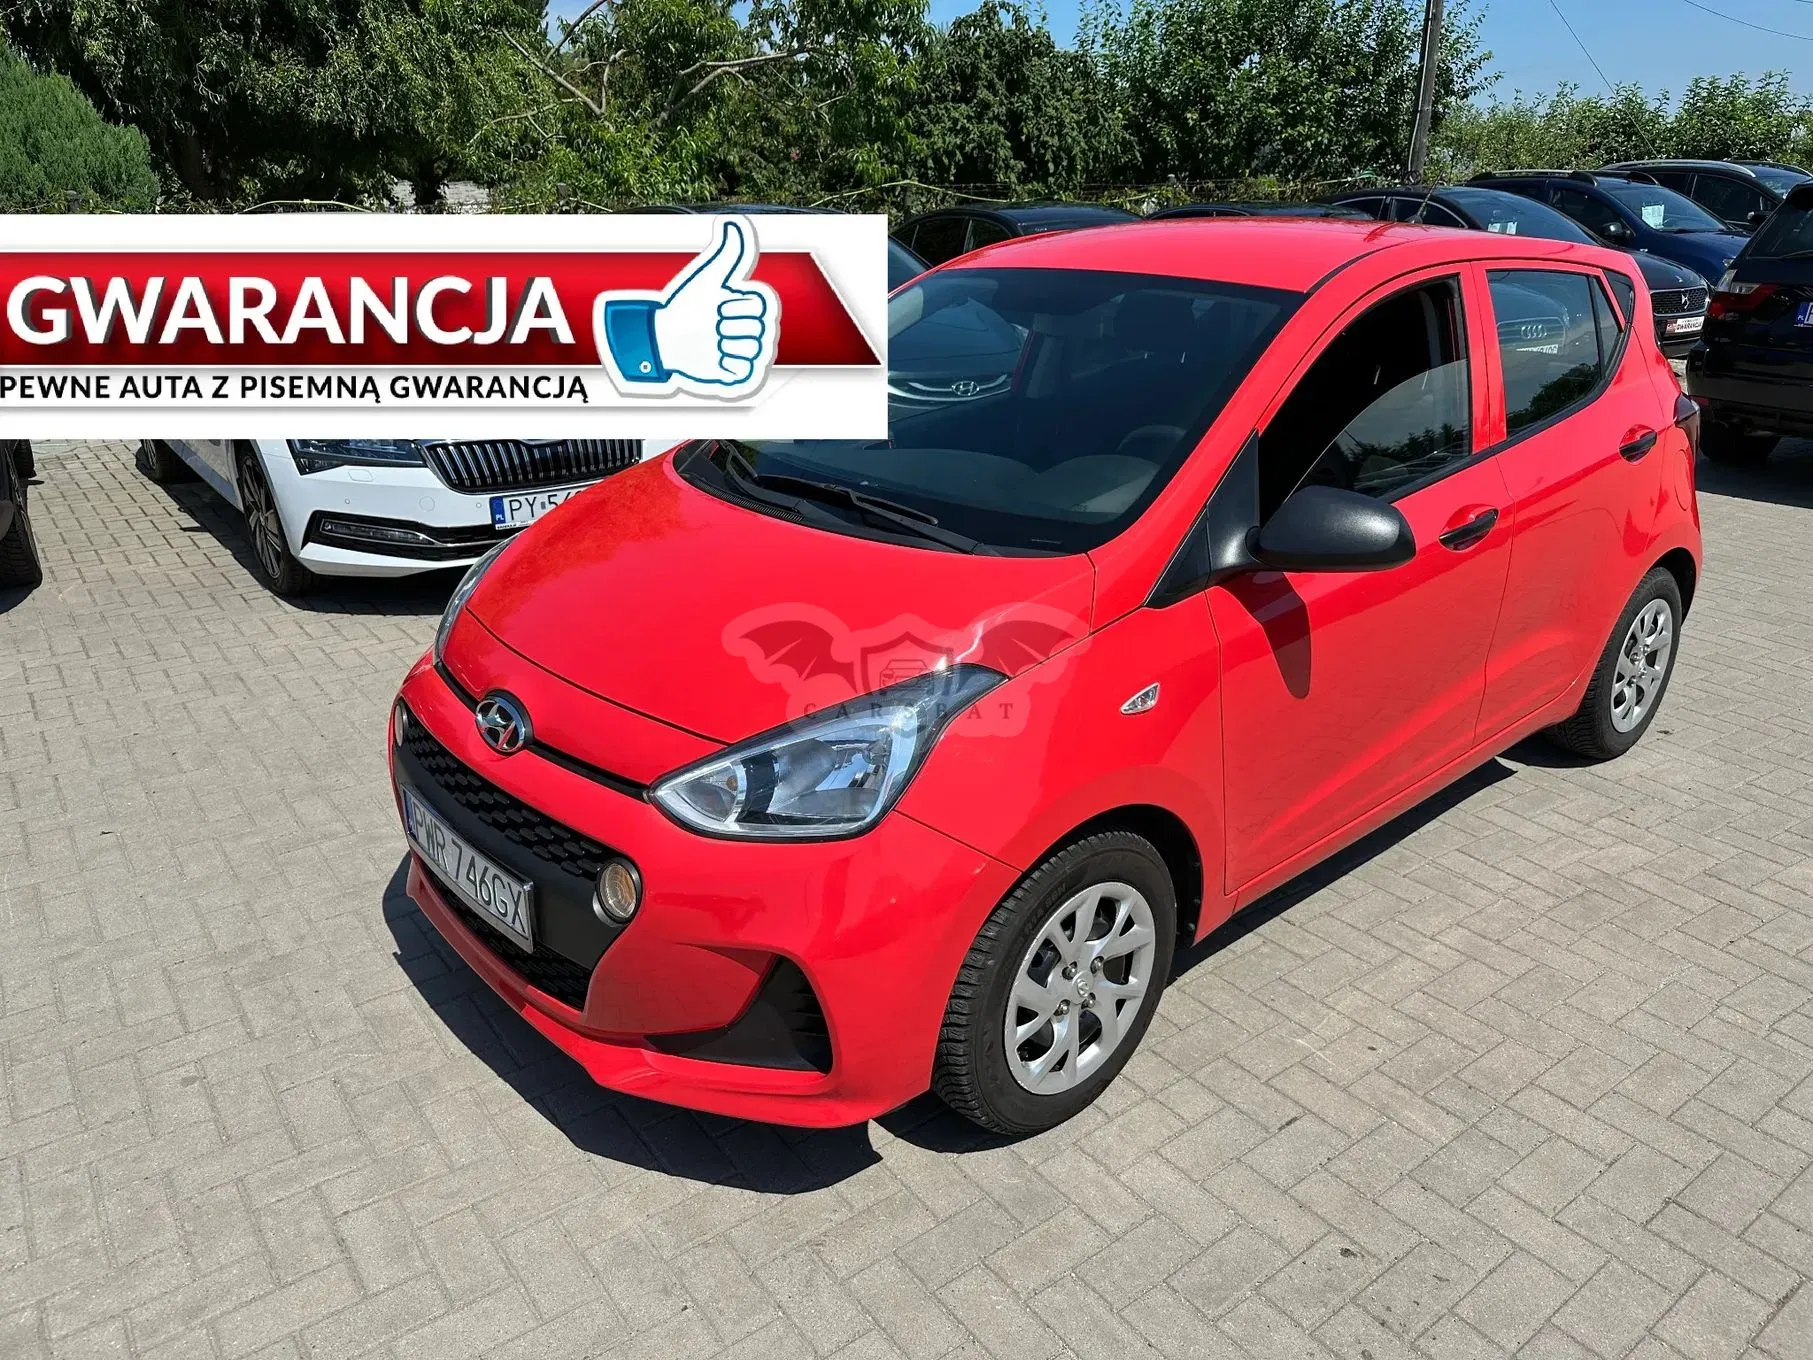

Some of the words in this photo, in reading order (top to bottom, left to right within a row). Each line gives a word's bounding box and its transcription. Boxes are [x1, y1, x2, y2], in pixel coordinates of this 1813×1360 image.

[508, 496, 537, 521] PY
[412, 802, 449, 871] PWR
[451, 841, 528, 935] 746GX
